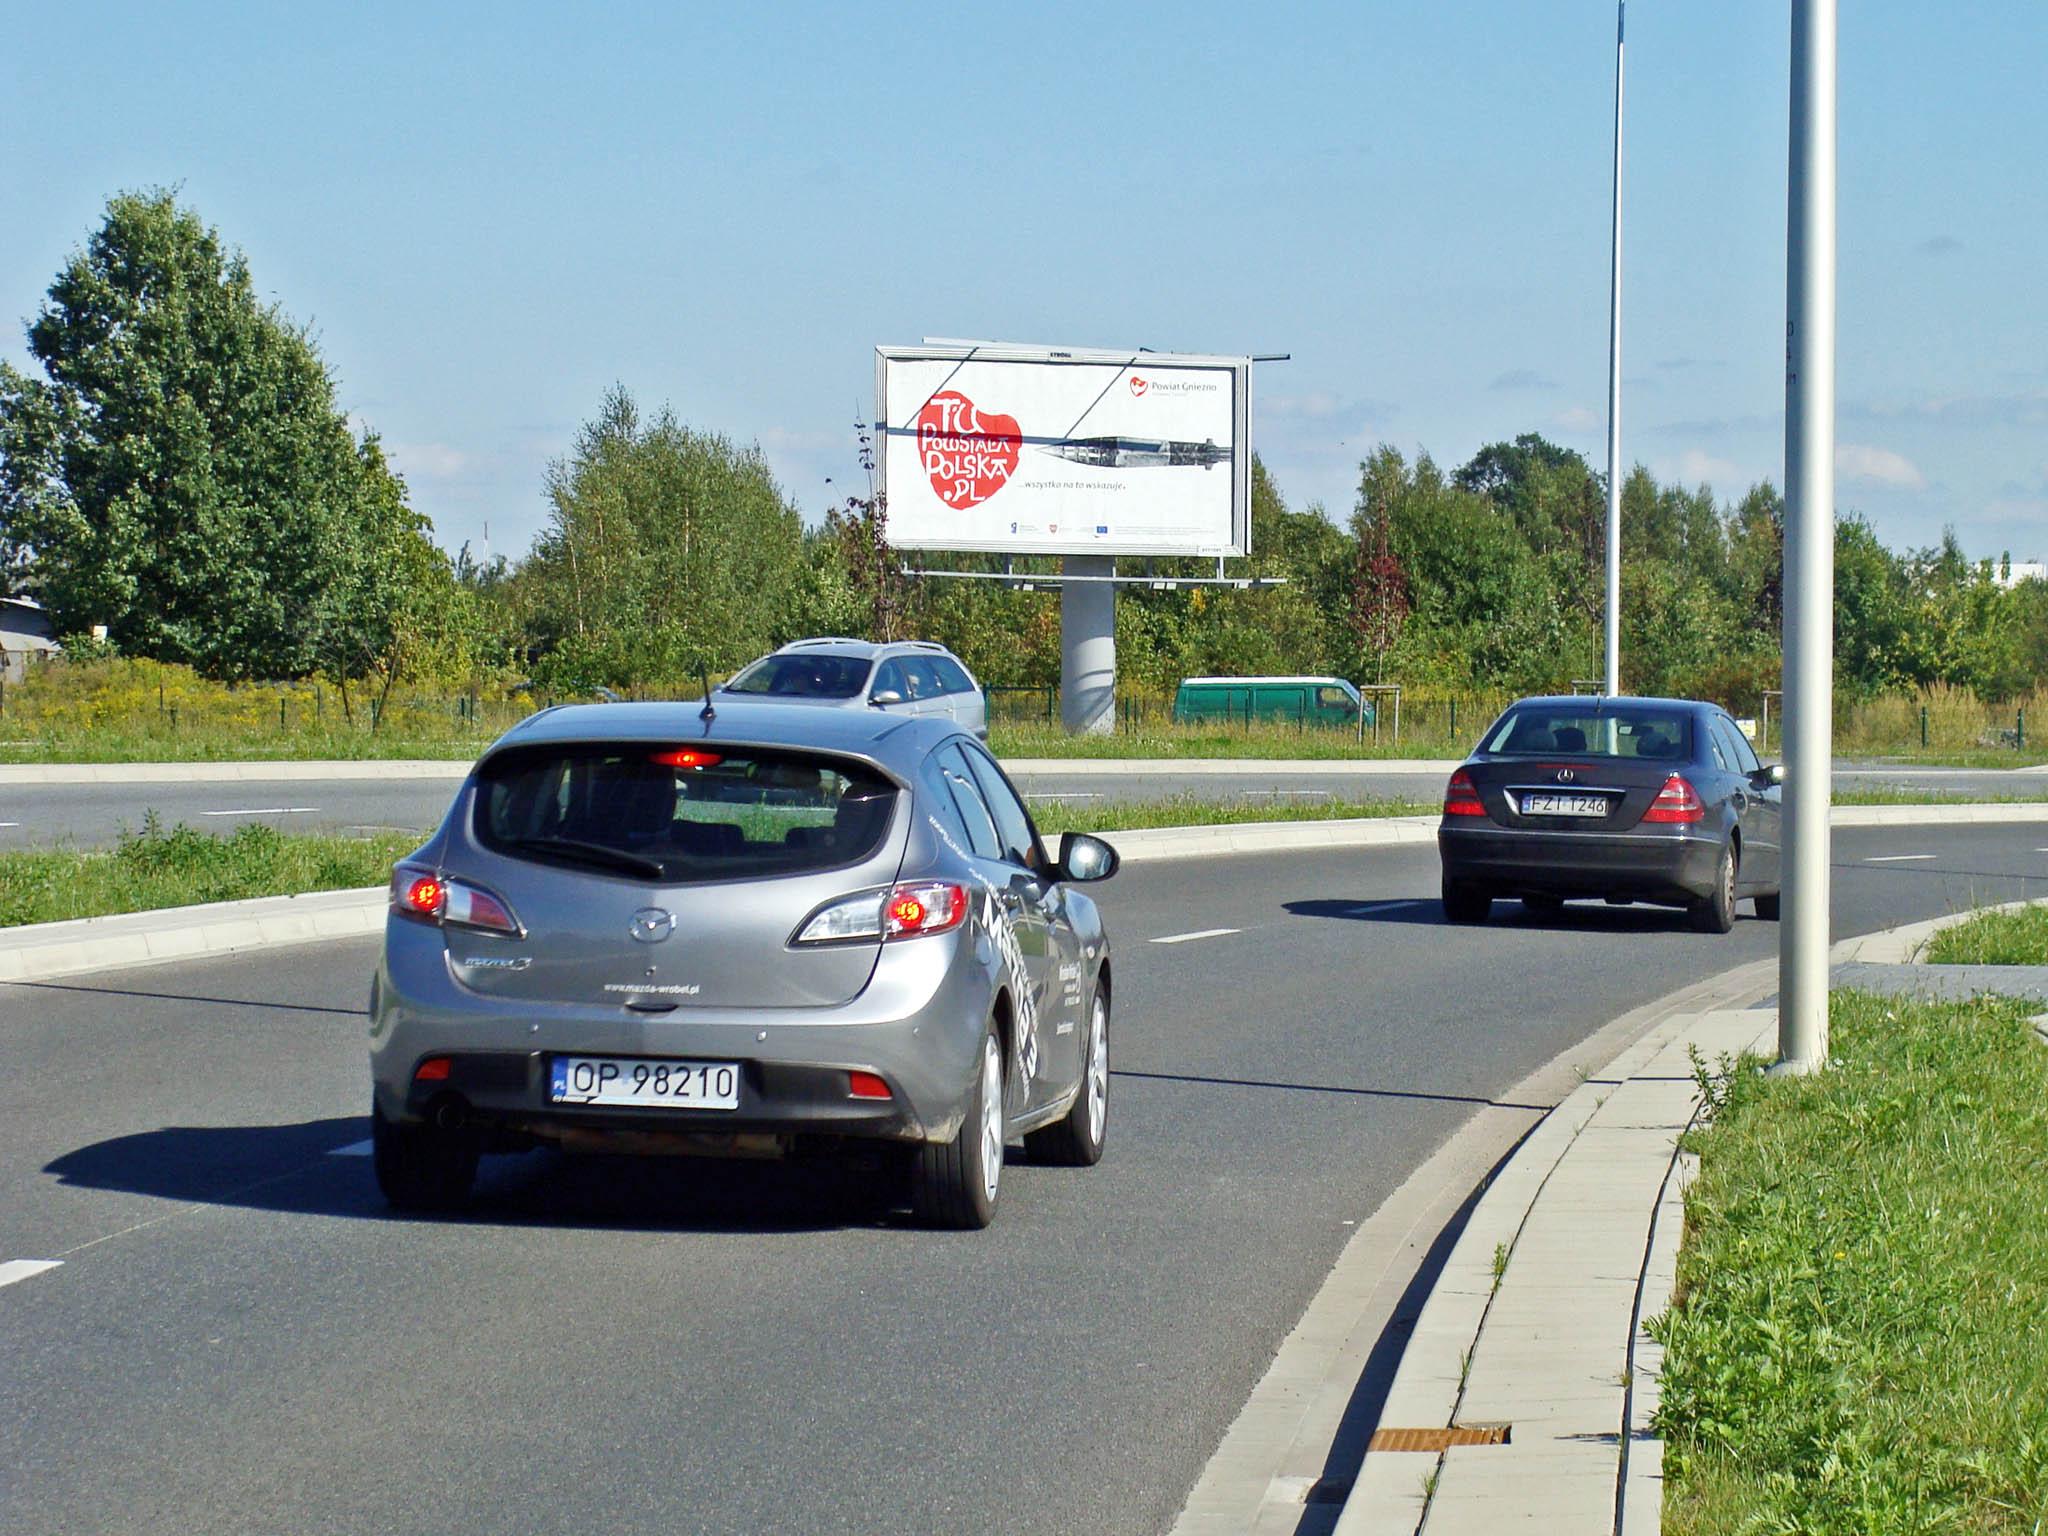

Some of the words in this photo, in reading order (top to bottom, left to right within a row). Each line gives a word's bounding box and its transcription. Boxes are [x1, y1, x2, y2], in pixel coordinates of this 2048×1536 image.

[1152, 382, 1180, 391] Powiat
[1182, 381, 1217, 392] Gniezno
[926, 450, 1011, 480] POLSKA
[1063, 481, 1074, 489] na
[1075, 480, 1085, 489] to
[1531, 795, 1561, 811] FZI
[604, 982, 700, 995] www.mazda-wrobel.pl
[574, 1061, 620, 1094] OP
[632, 1064, 732, 1098] 98210
